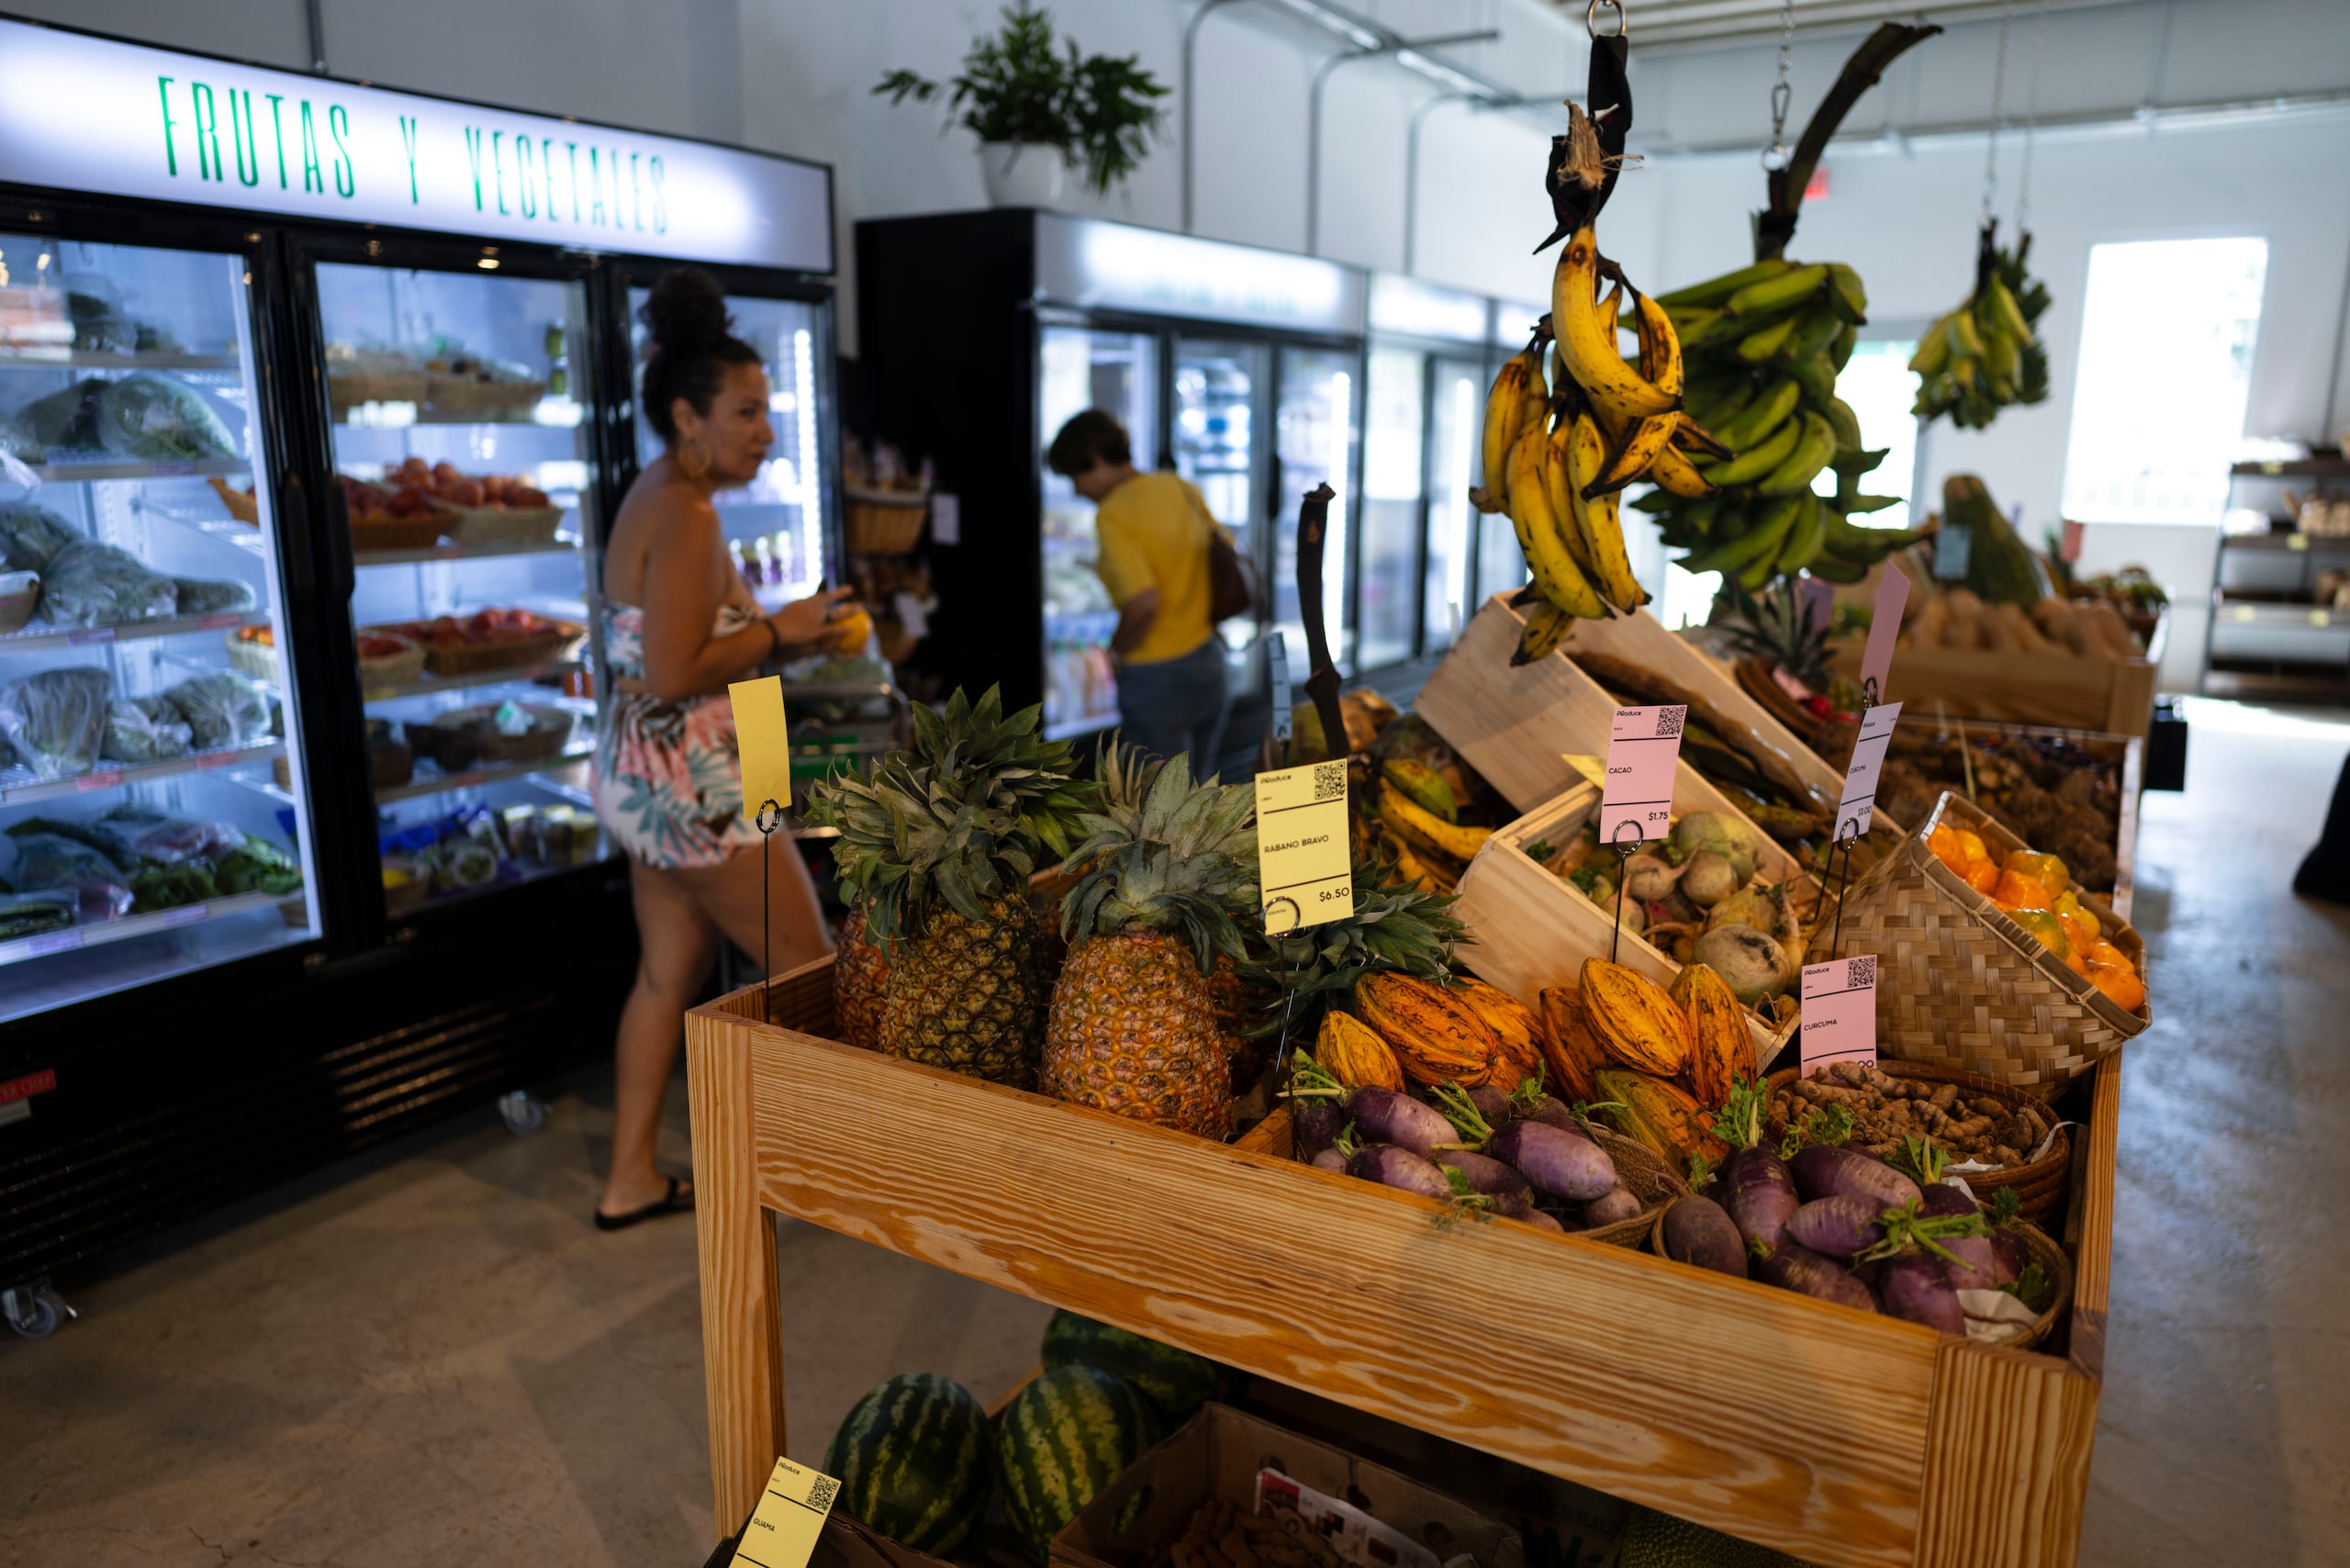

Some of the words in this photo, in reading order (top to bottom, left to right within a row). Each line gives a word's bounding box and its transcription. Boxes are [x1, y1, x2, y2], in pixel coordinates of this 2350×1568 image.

[158, 75, 354, 198] FRUTAS
[400, 116, 418, 205] Y
[465, 126, 666, 235] VEGETALES
[1648, 812, 1668, 821] $1.75
[1264, 840, 1299, 853] RABANO
[1302, 834, 1329, 846] BRAVO
[1319, 887, 1349, 902] $6.50
[1804, 1019, 1837, 1031] CURCUMA
[753, 1518, 775, 1532] GUAMA
